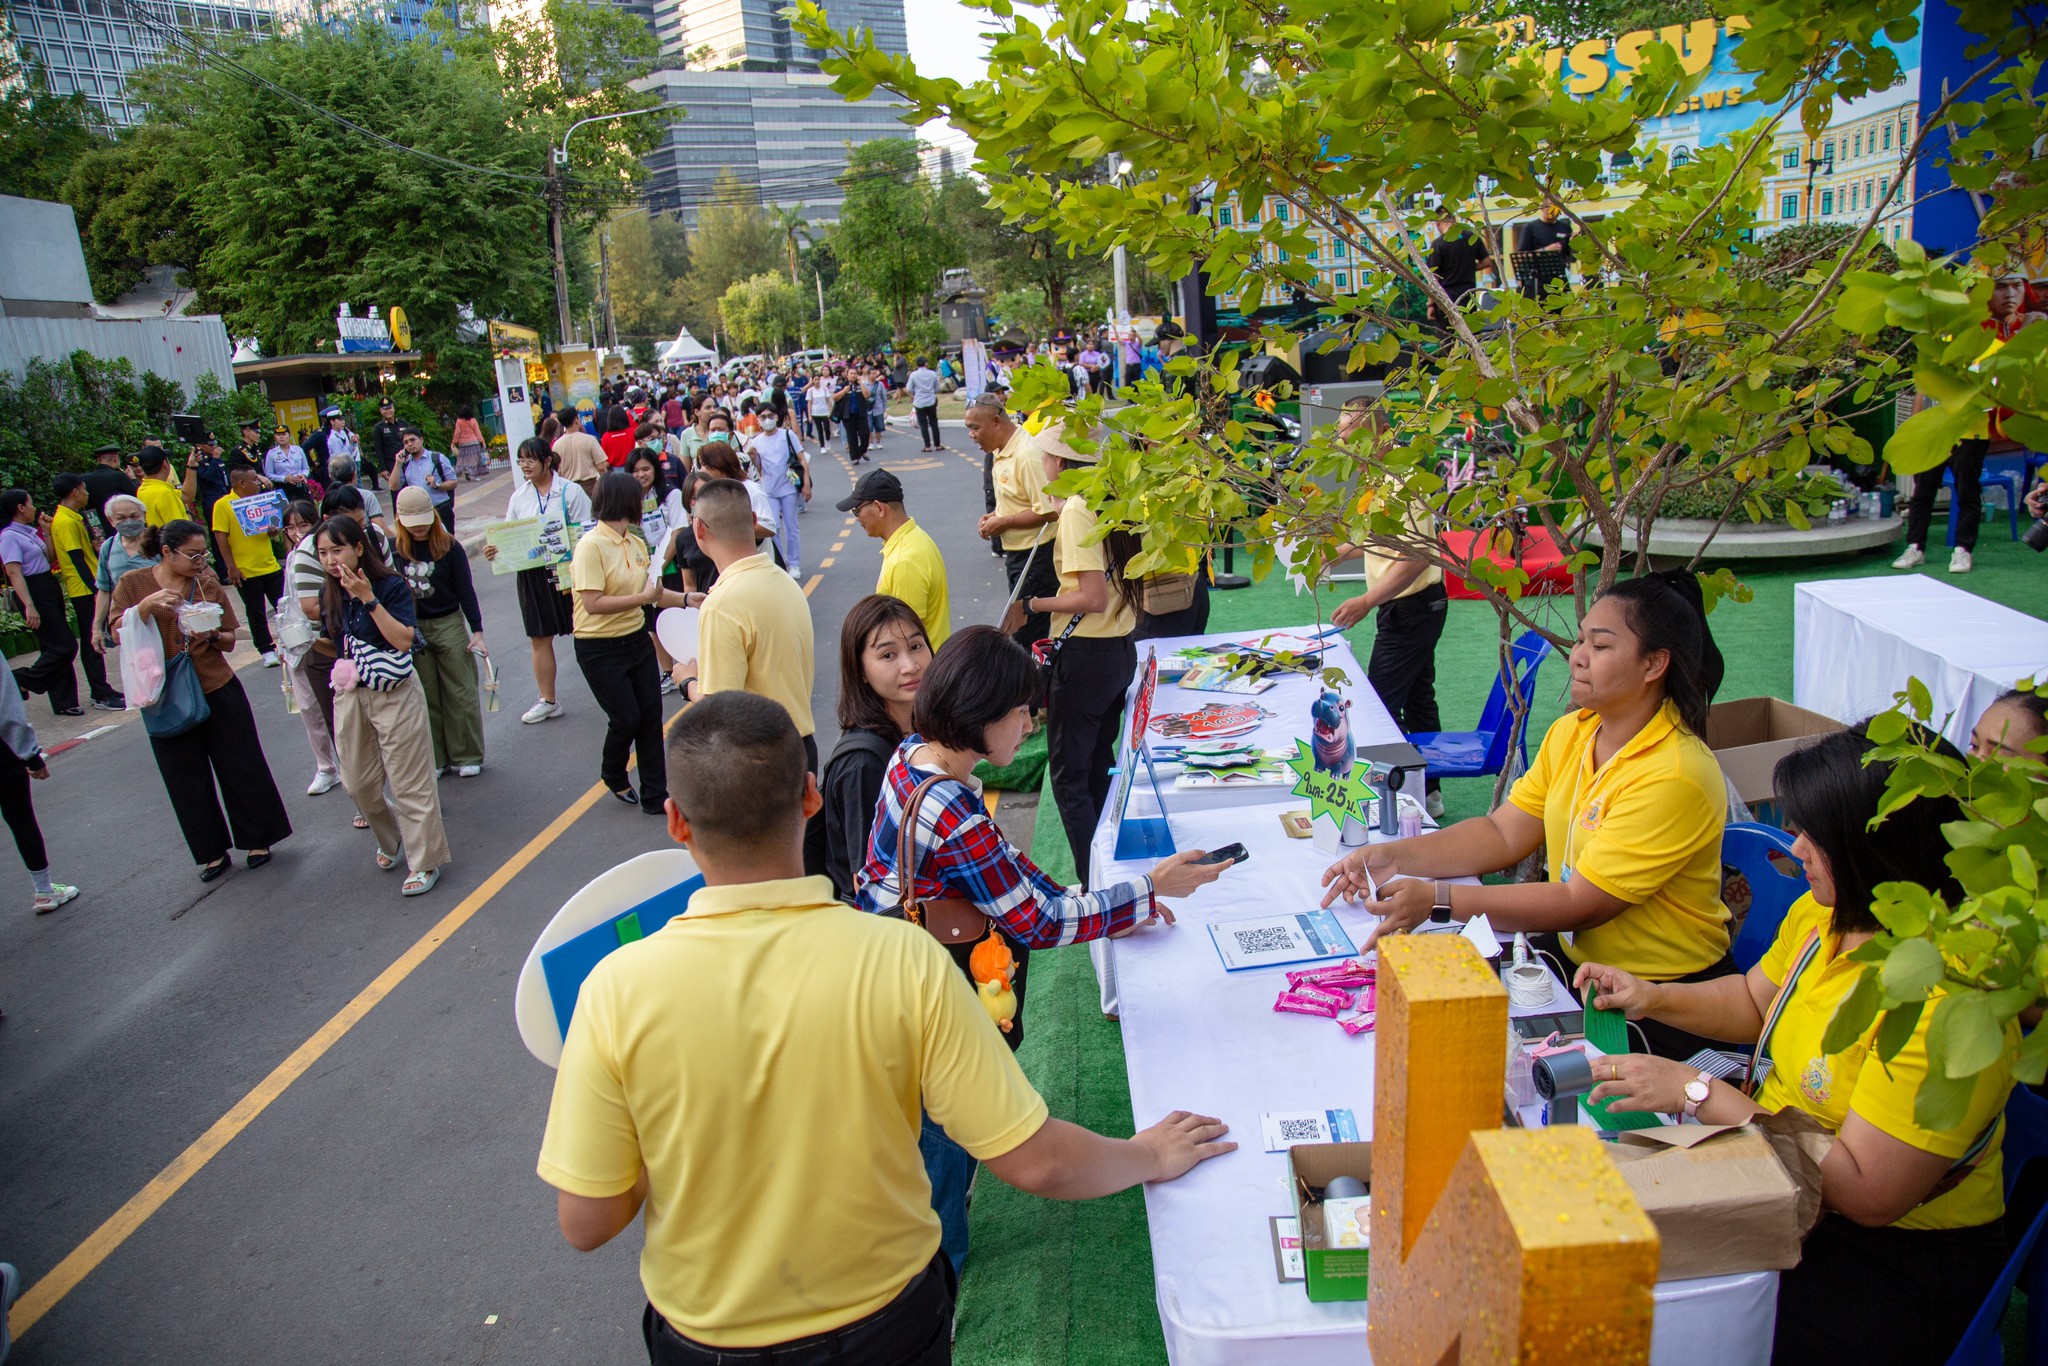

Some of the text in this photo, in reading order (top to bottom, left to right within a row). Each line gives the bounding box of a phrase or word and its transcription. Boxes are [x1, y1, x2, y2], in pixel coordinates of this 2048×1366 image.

[247, 508, 263, 519] 50
[1061, 624, 1074, 639] FILA
[1326, 782, 1348, 808] 25
